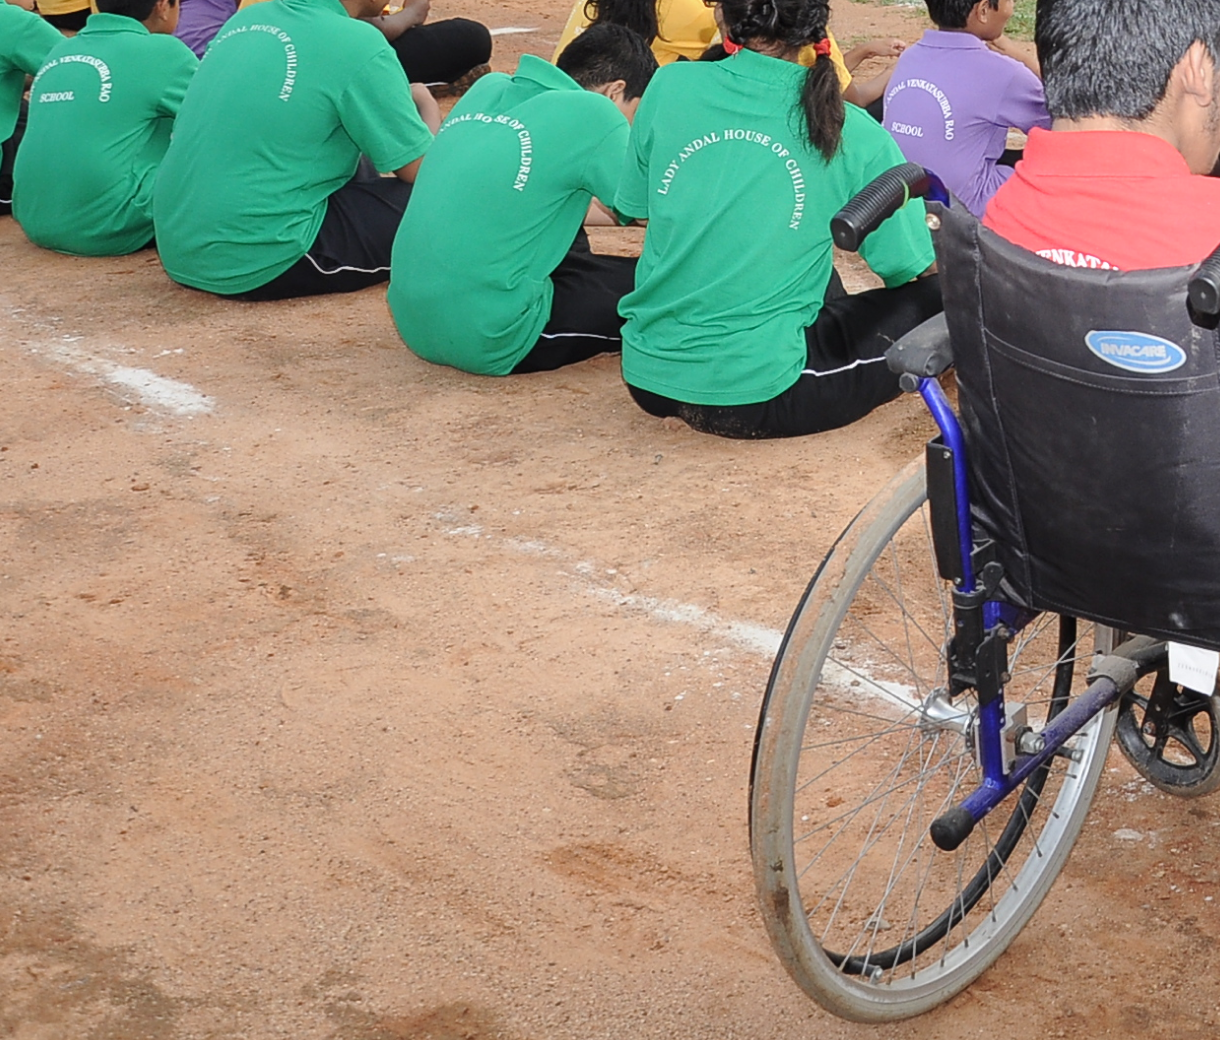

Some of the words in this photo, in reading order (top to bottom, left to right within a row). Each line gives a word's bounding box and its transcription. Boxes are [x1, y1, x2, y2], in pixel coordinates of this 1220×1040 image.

[277, 31, 292, 43] OF
[278, 43, 298, 102] CHILDREN
[38, 91, 75, 103] SCHOOL
[473, 112, 511, 125] HOSE
[508, 118, 525, 131] OF
[891, 121, 924, 138] SCHOOL
[944, 119, 955, 141] RAO
[512, 129, 533, 192] CHILDREN
[657, 159, 680, 196] LADY
[678, 132, 720, 162] ANDAL
[723, 129, 772, 147] HOUSE
[771, 142, 790, 158] OF
[785, 158, 806, 231] CHILDREN
[1100, 342, 1167, 358] INVACARE
